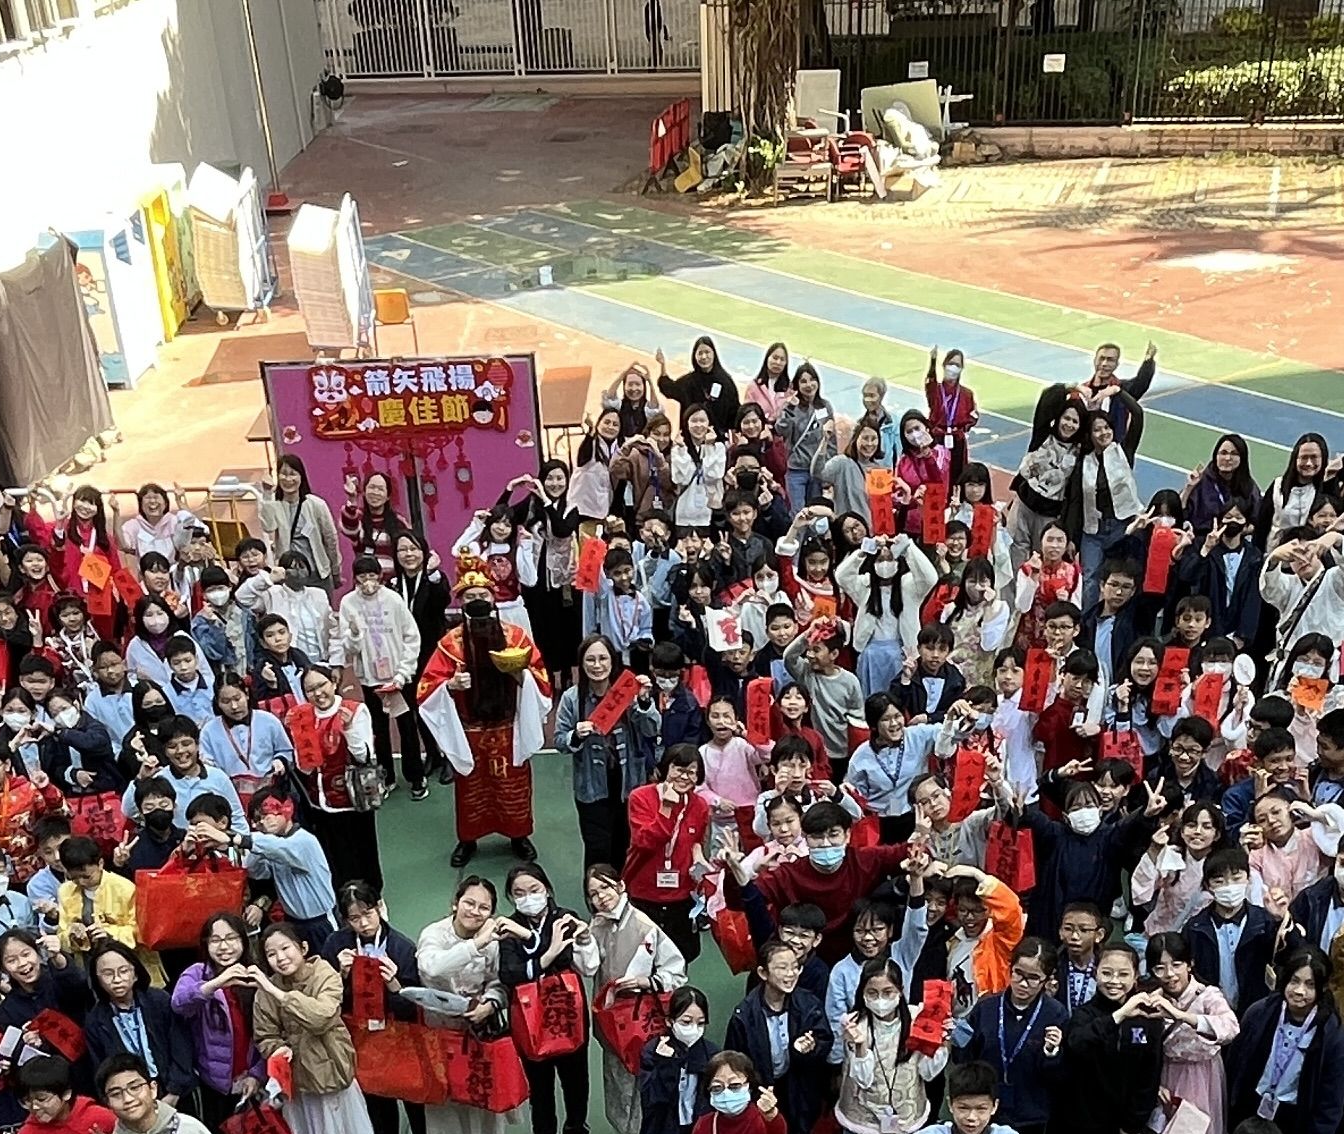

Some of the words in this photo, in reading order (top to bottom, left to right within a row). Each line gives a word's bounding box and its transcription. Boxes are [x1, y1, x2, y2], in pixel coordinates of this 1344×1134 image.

[364, 364, 476, 396] 箭矢飛揚
[377, 394, 469, 427] 慶佳節
